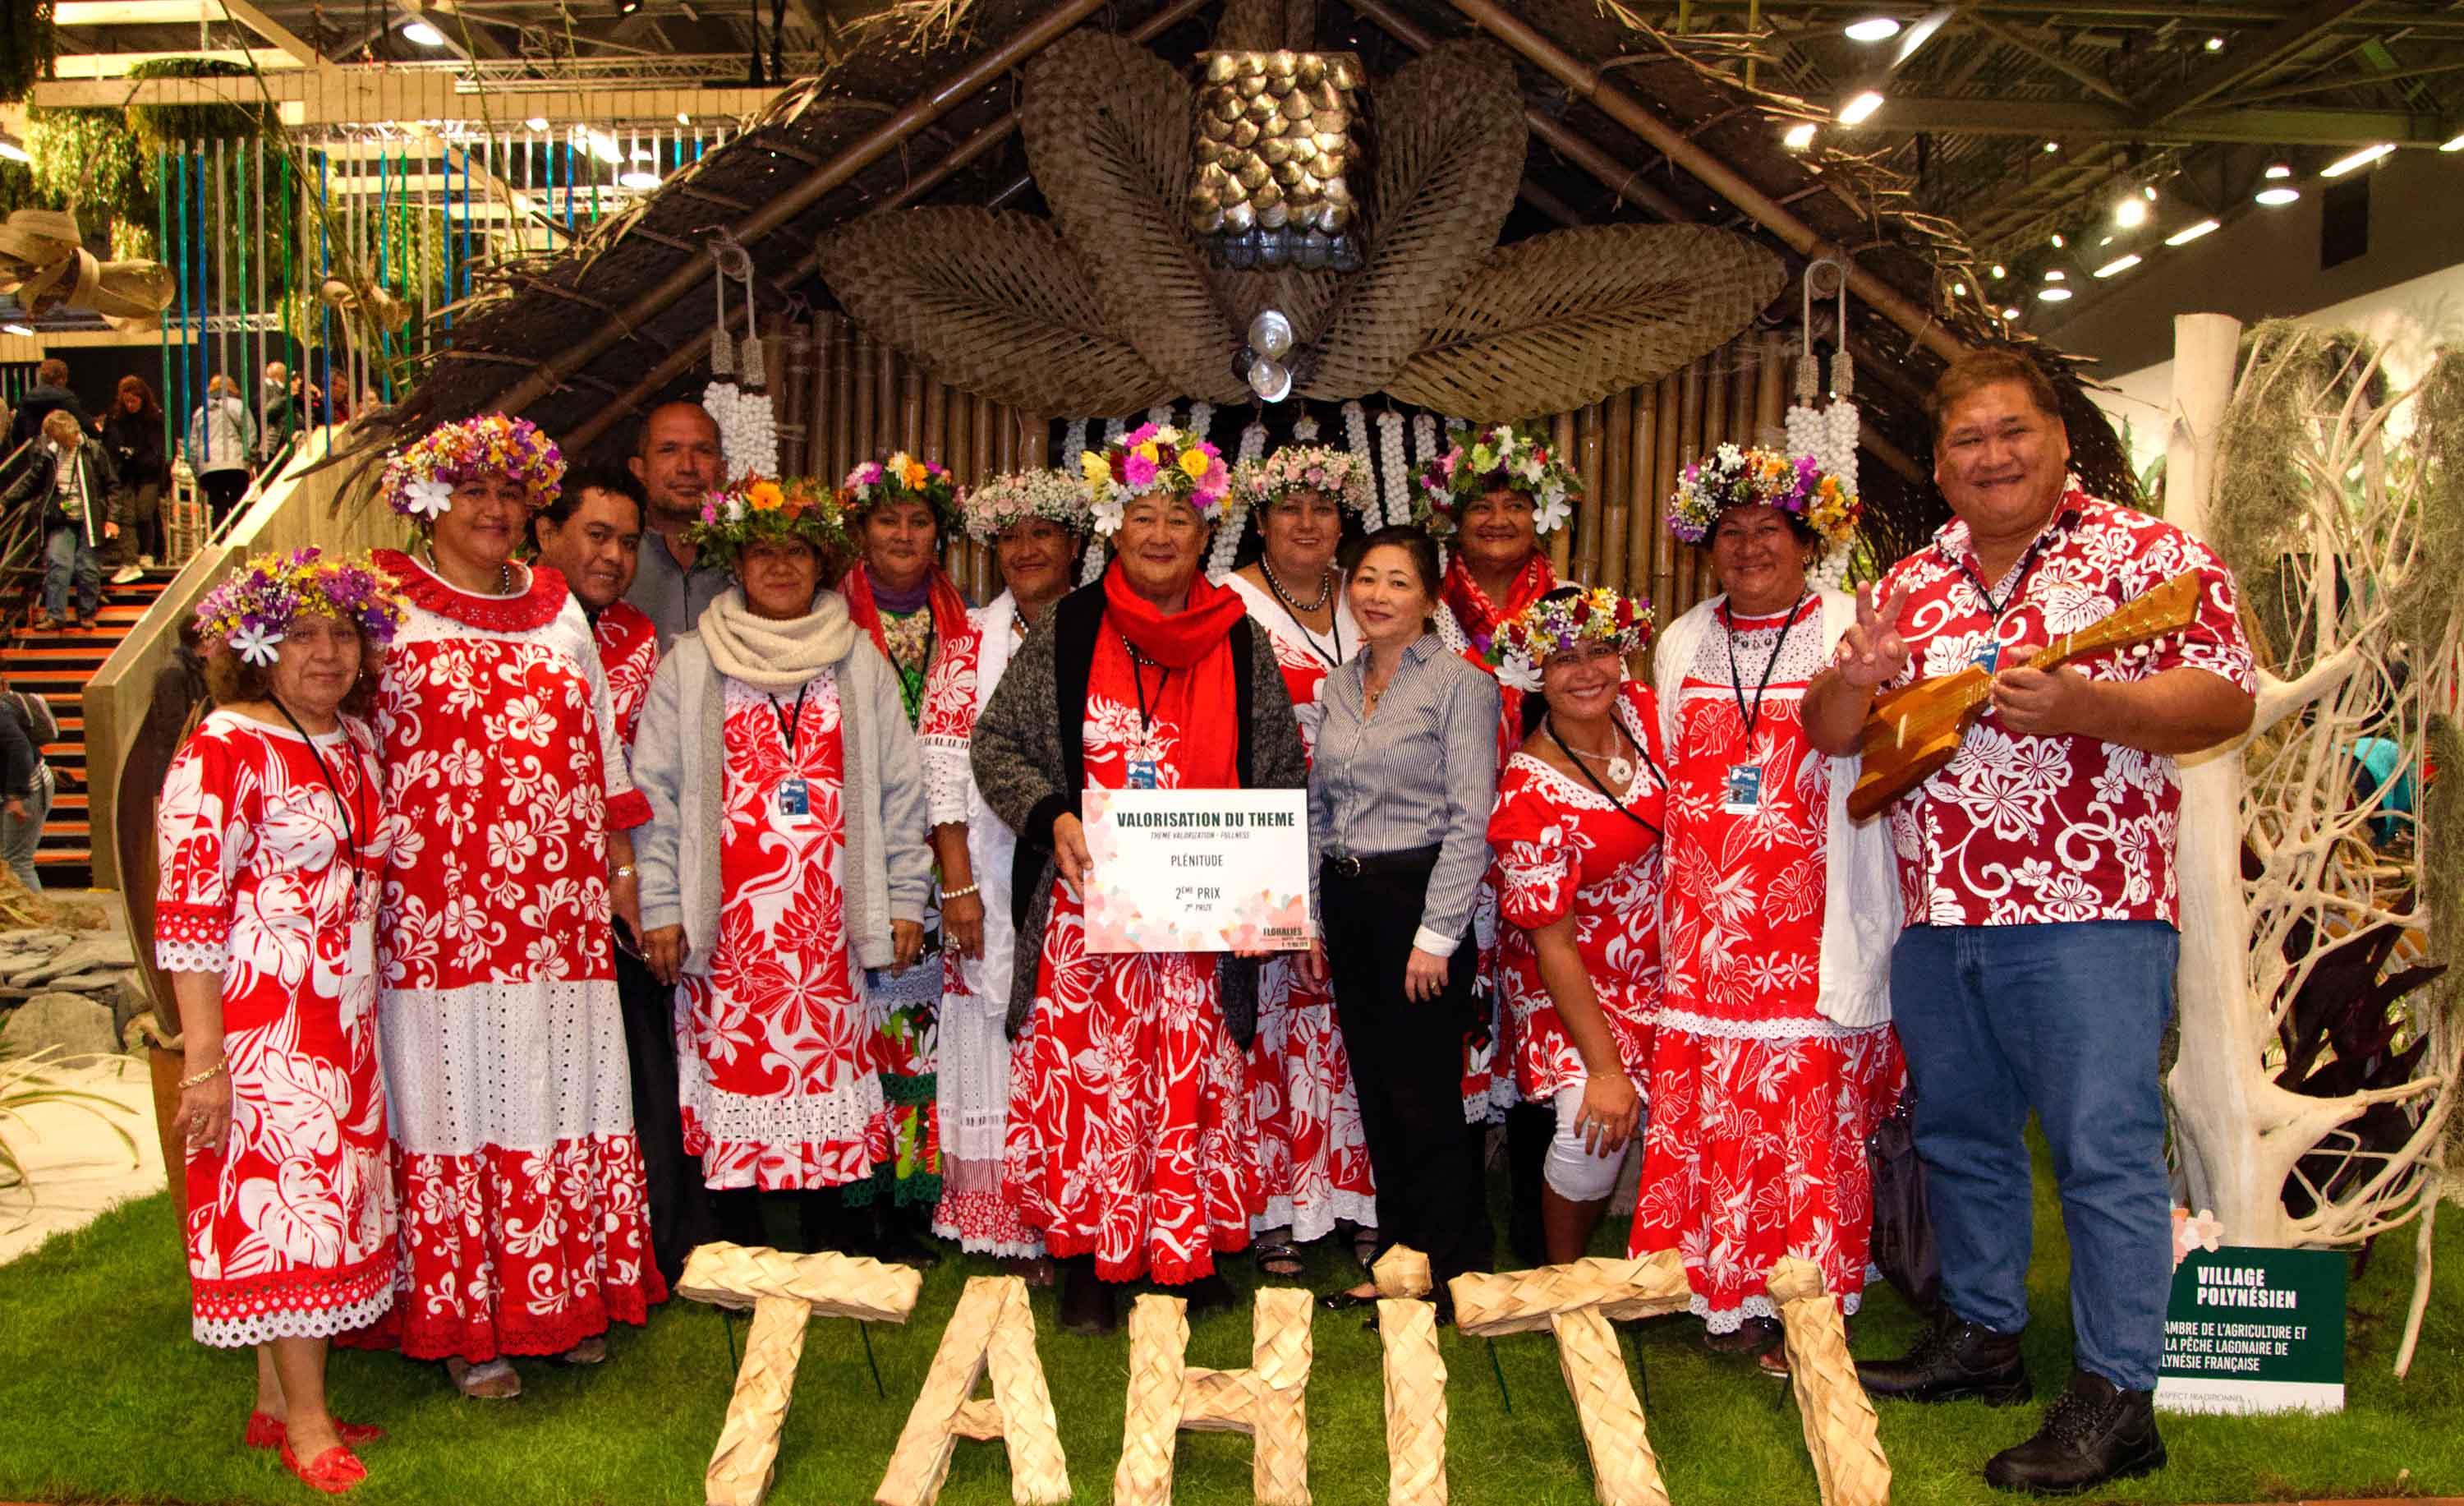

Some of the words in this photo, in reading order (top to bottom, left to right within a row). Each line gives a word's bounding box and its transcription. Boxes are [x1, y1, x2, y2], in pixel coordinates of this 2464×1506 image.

[1117, 812, 1221, 827] VALORISATION
[1225, 812, 1244, 827] DU
[1248, 812, 1294, 827] THEME
[1170, 854, 1224, 867] PLÉNITUDE
[1198, 887, 1221, 900] PRIX
[2197, 1266, 2265, 1287] VILLAGE
[2197, 1287, 2296, 1309] POLYNÉSIEN
[2164, 1321, 2199, 1335] AMBRE
[2201, 1322, 2215, 1336] DE
[2218, 1323, 2292, 1339] L'AGRICULTURE
[2295, 1326, 2307, 1340] ET
[2165, 1338, 2177, 1352] LA
[2180, 1336, 2213, 1352] PÊCHE
[2216, 1339, 2272, 1355] LAGONAIRE
[2275, 1342, 2289, 1356] DE
[2162, 1352, 2202, 1369] LYNÉSIE
[2204, 1356, 2260, 1372] FRANÇAISE
